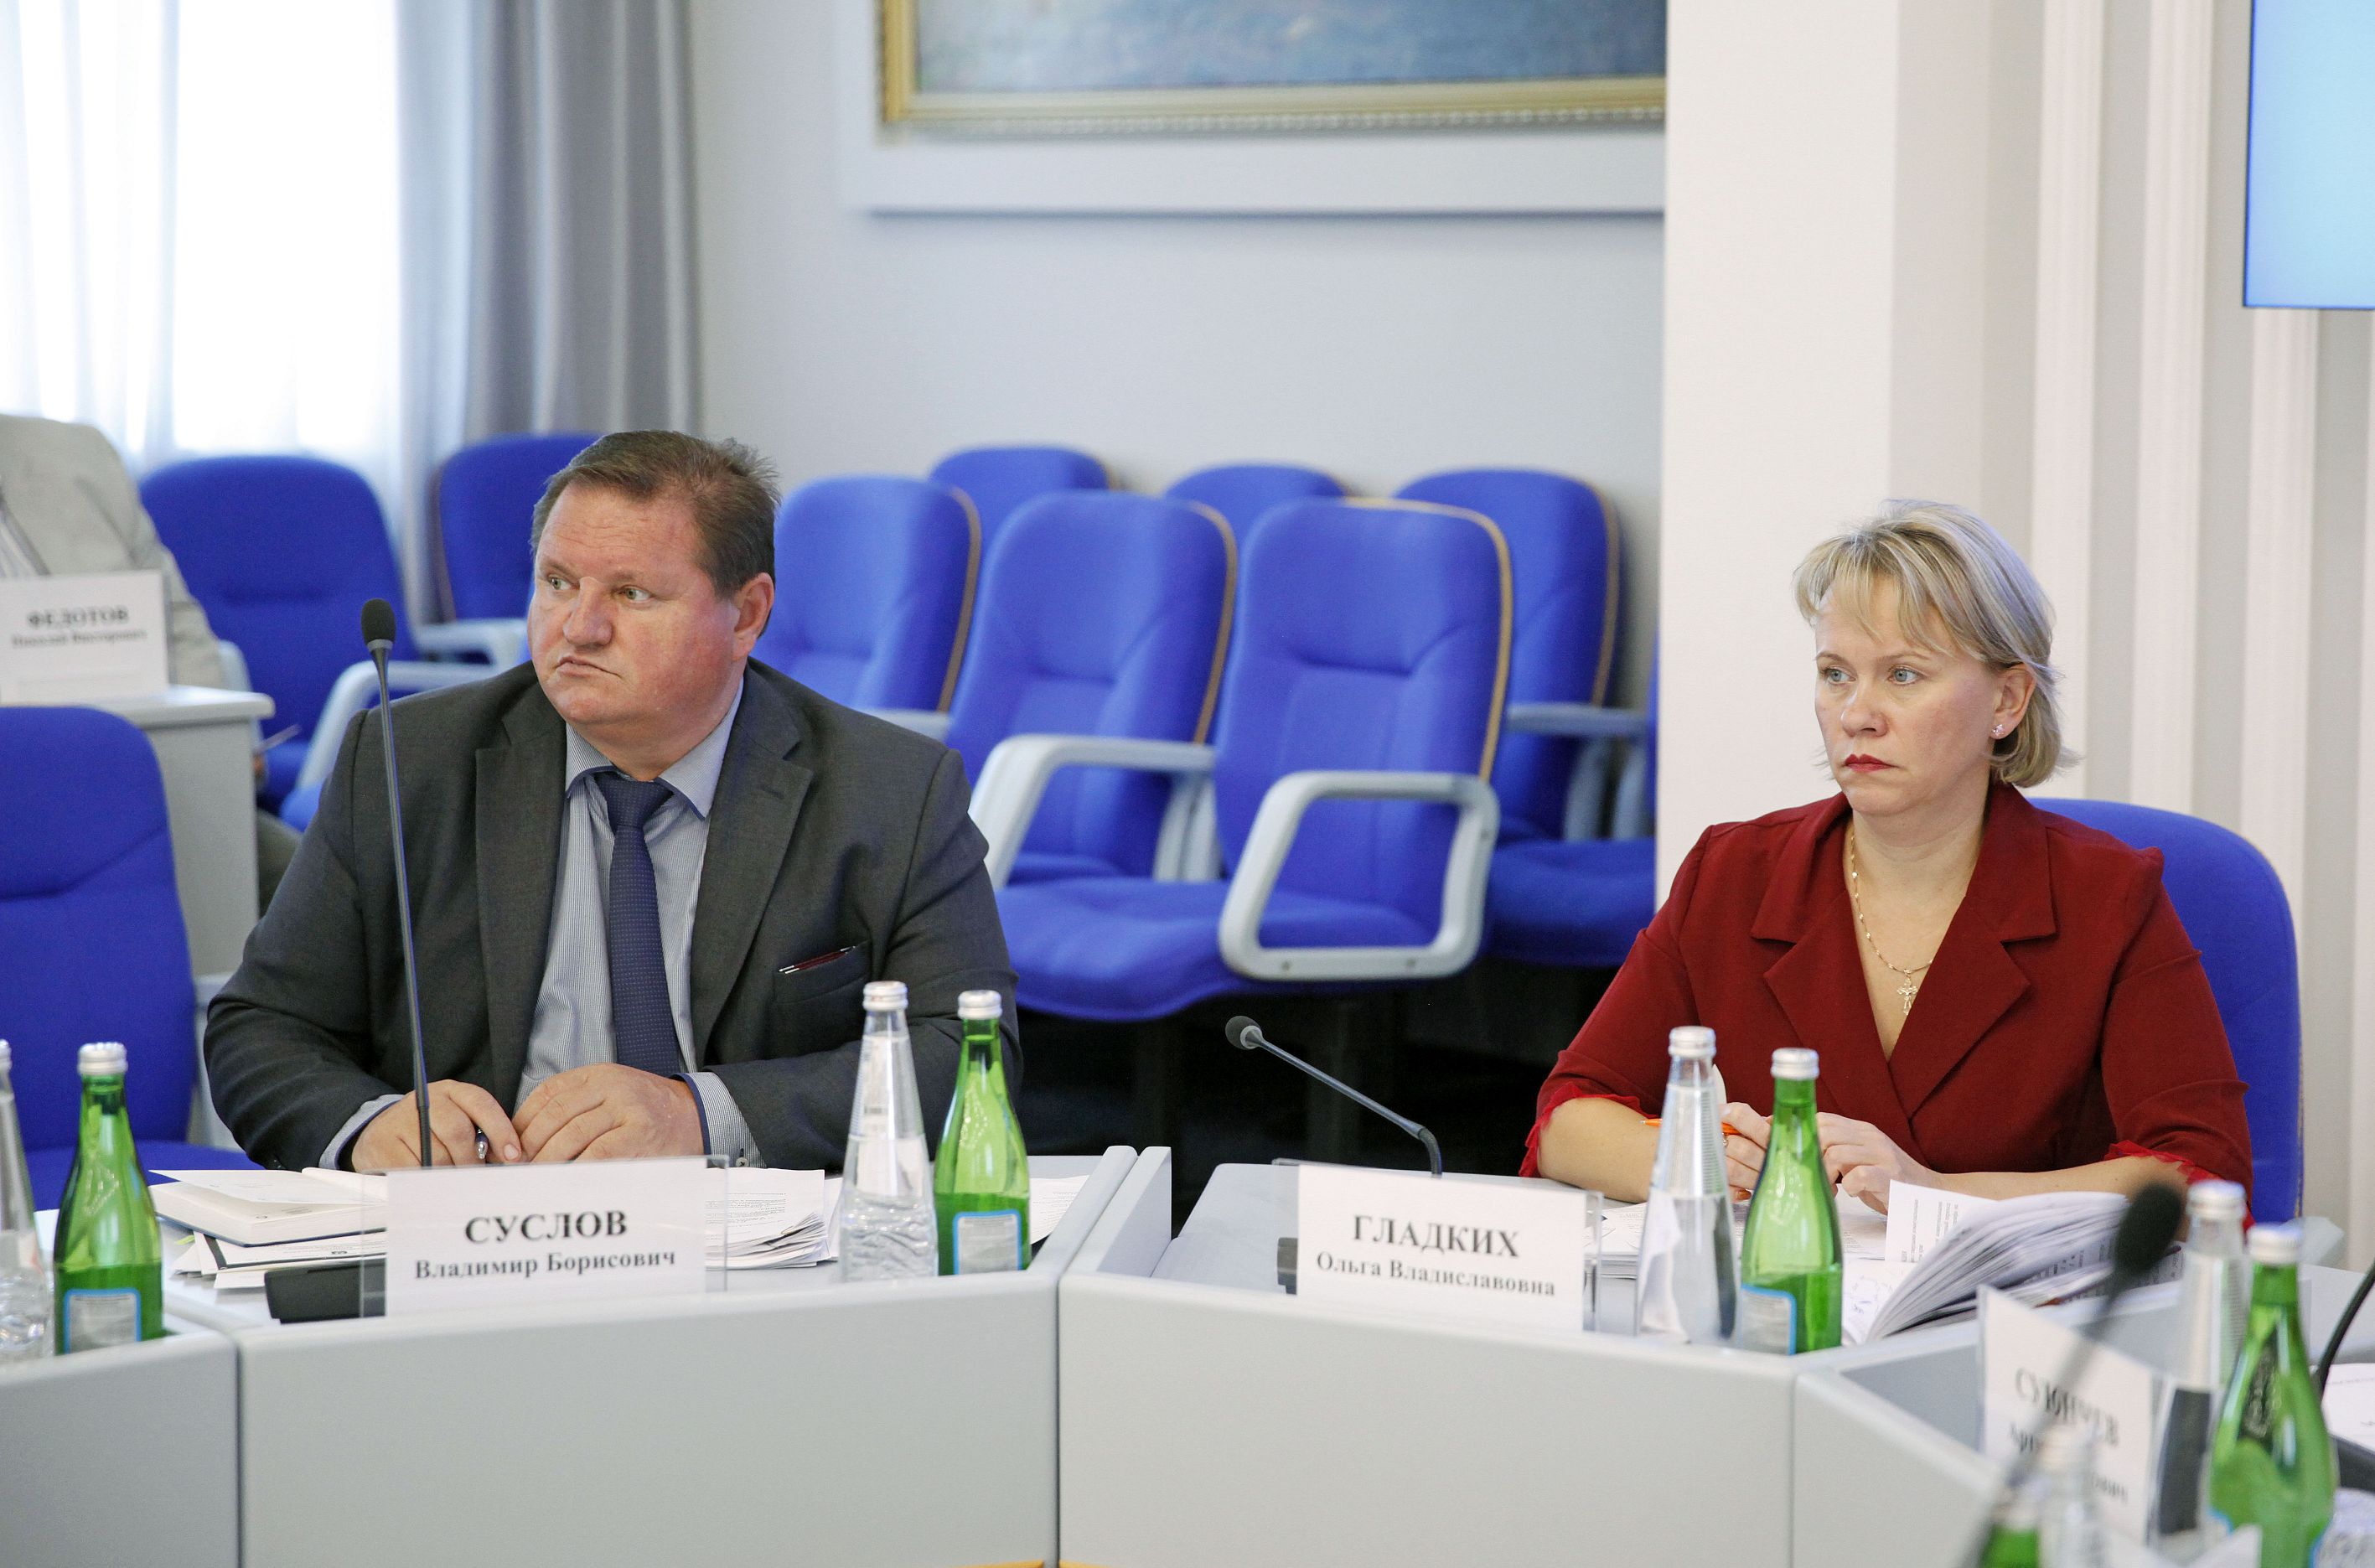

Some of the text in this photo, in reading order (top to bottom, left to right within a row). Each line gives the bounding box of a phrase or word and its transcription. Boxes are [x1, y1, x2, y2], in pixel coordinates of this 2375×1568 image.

[464, 1209, 628, 1245] СУСЛОВ
[1353, 1215, 1519, 1257] ГЛАДКИХ
[415, 1252, 675, 1280] Владимир Борисович
[1317, 1251, 1555, 1296] Ольга Владиславовна
